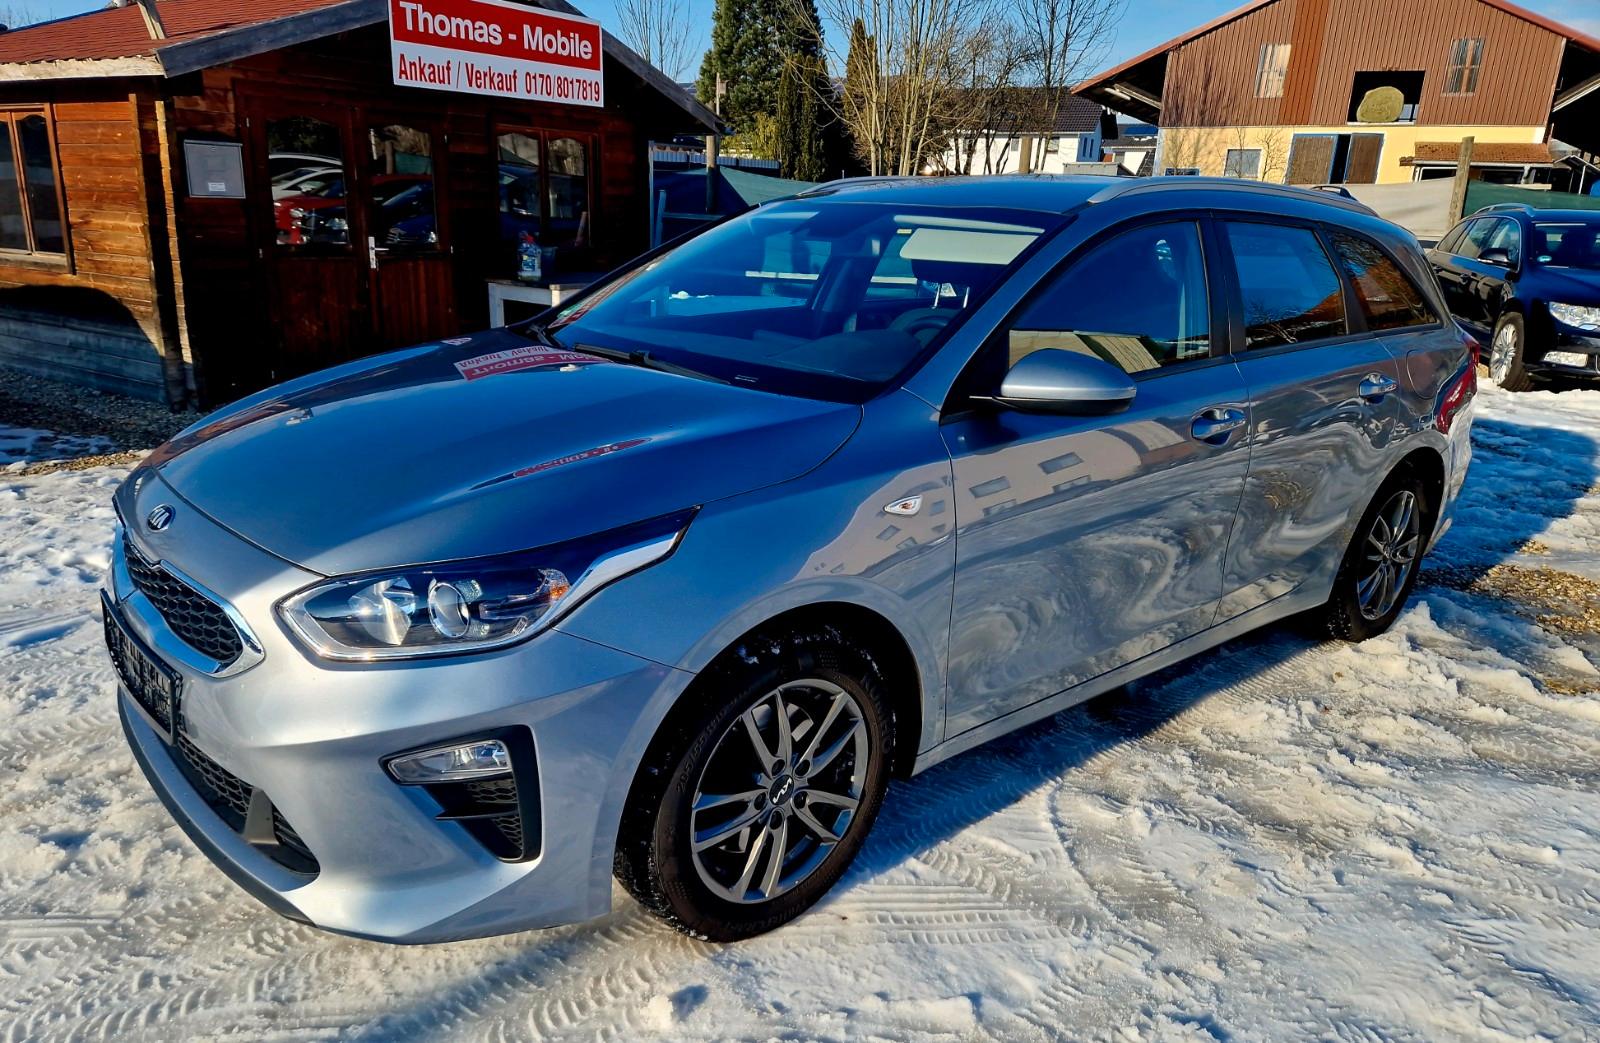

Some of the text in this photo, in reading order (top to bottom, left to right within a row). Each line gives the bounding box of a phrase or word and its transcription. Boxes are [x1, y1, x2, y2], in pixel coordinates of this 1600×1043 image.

[400, 1, 593, 60] Thomas - Mobile
[399, 53, 452, 85] Ankauf
[465, 62, 518, 93] Verkauf
[525, 71, 600, 102] 0170/8017819
